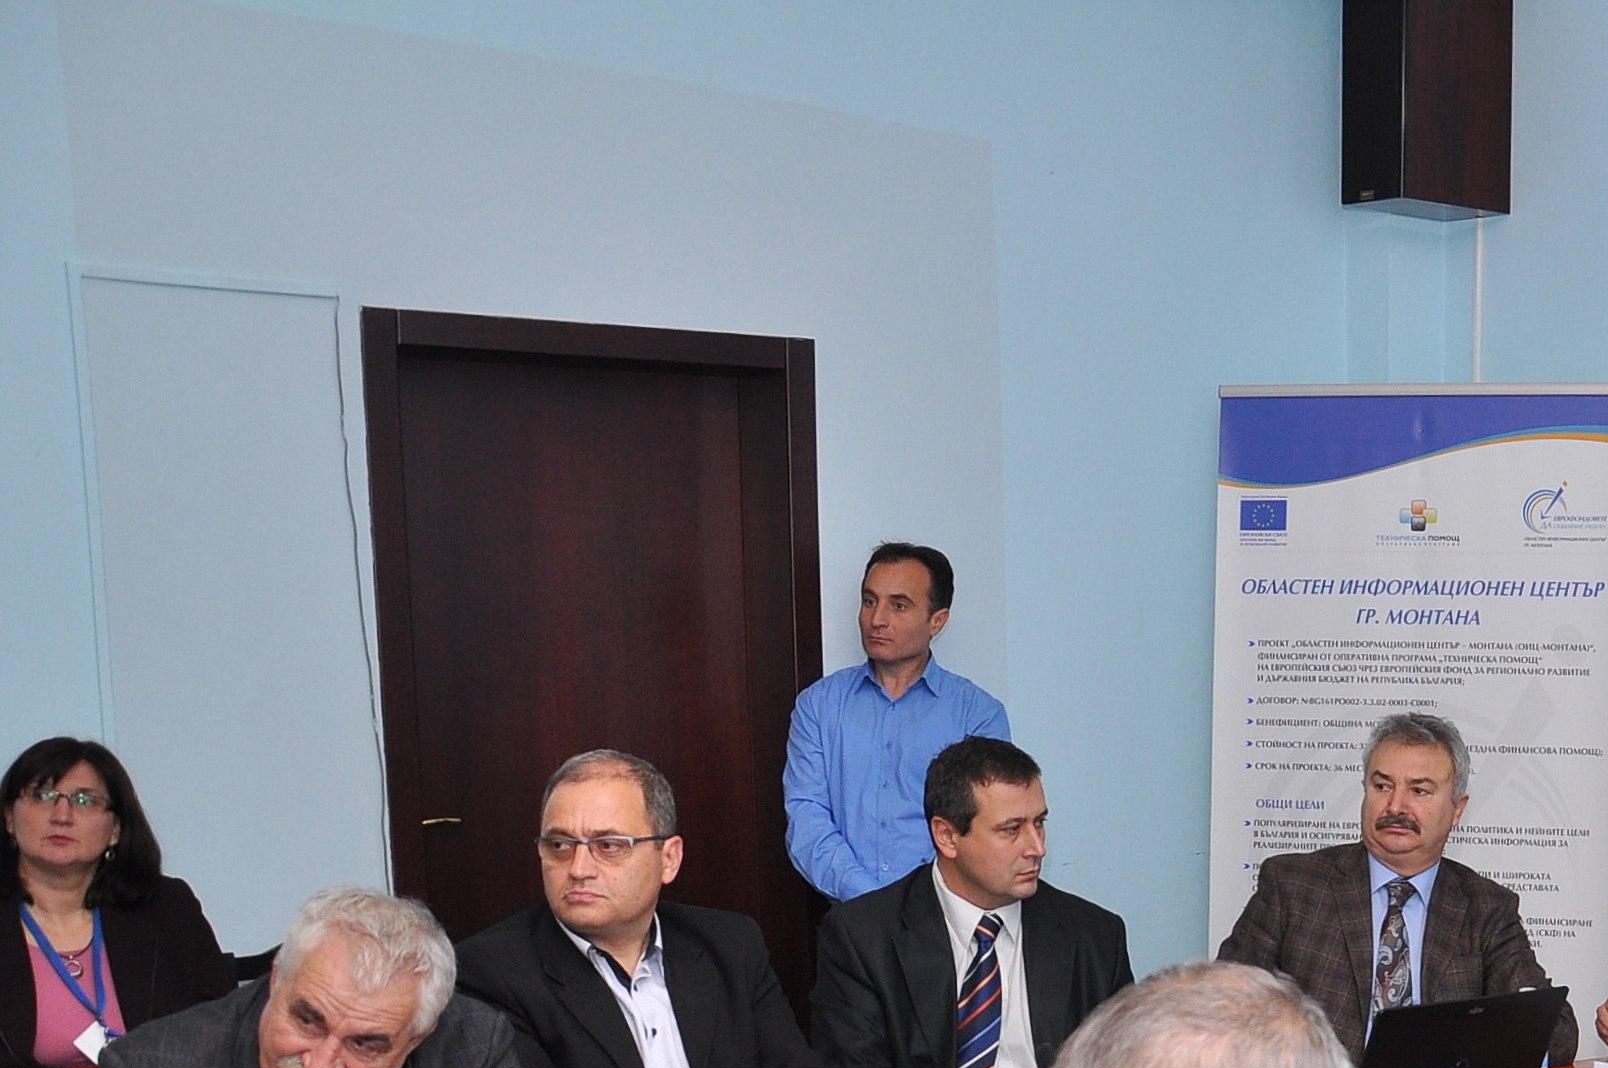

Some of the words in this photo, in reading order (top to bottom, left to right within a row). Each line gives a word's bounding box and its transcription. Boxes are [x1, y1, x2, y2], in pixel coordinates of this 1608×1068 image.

[1241, 578, 1334, 595] ОБЛАСТЕН
[1339, 579, 1525, 599] ИНФОРМАЦИОНЕН
[1529, 581, 1606, 600] ЦЕНТЪР
[1355, 608, 1380, 625] ГР.
[1385, 609, 1481, 626] МОНТАНА
[1258, 640, 1289, 648] ПРОЕКТ
[1340, 640, 1425, 650] ИНФОРМАЦИОНЕН
[1426, 642, 1460, 650] ЦЕНТЪР
[1469, 642, 1513, 650] МОНТАНА
[1258, 652, 1318, 661] ФИНАНСИРАН
[1320, 653, 1332, 661] ОТ
[1333, 654, 1390, 662] ОПЕРАТИВНА
[1392, 654, 1437, 662] ПРОГРАМА
[1258, 664, 1270, 672] НА
[1270, 663, 1330, 672] ЕВРОПЕЙСКИЯ
[1332, 664, 1357, 672] СЪЮЗ
[1358, 664, 1378, 672] ЧРЕЗ
[1380, 665, 1442, 674] ЕВРОПЕЙСКИЯ
[1443, 666, 1472, 675] ФОНД
[1486, 667, 1546, 676] РЕГИОНАЛНО
[1547, 668, 1590, 676] РАЗВИТИЕ
[1357, 676, 1369, 684] НА
[1371, 676, 1419, 684] РЕПУБЛИКА
[1322, 720, 1363, 729] ОБЩИНА
[1256, 740, 1302, 748] СТОЙНОСТ
[1498, 746, 1557, 755] ФИНАНСОВА
[1255, 762, 1278, 770] СРОК
[1256, 799, 1292, 810] ОБЩИ
[1296, 800, 1324, 811] ЦЕЛИ
[1466, 826, 1514, 834] ПОЛИТИКА
[1516, 826, 1523, 834] И
[1566, 828, 1590, 837] ЦЕЛИ
[1490, 837, 1556, 848] ИНФОРМАЦИЯ
[1558, 839, 1568, 848] ЗА
[1502, 872, 1552, 880] ШИРОКАТА
[1526, 918, 1592, 927] ФИНАНСИРАНЕ
[1564, 930, 1576, 938] НА
